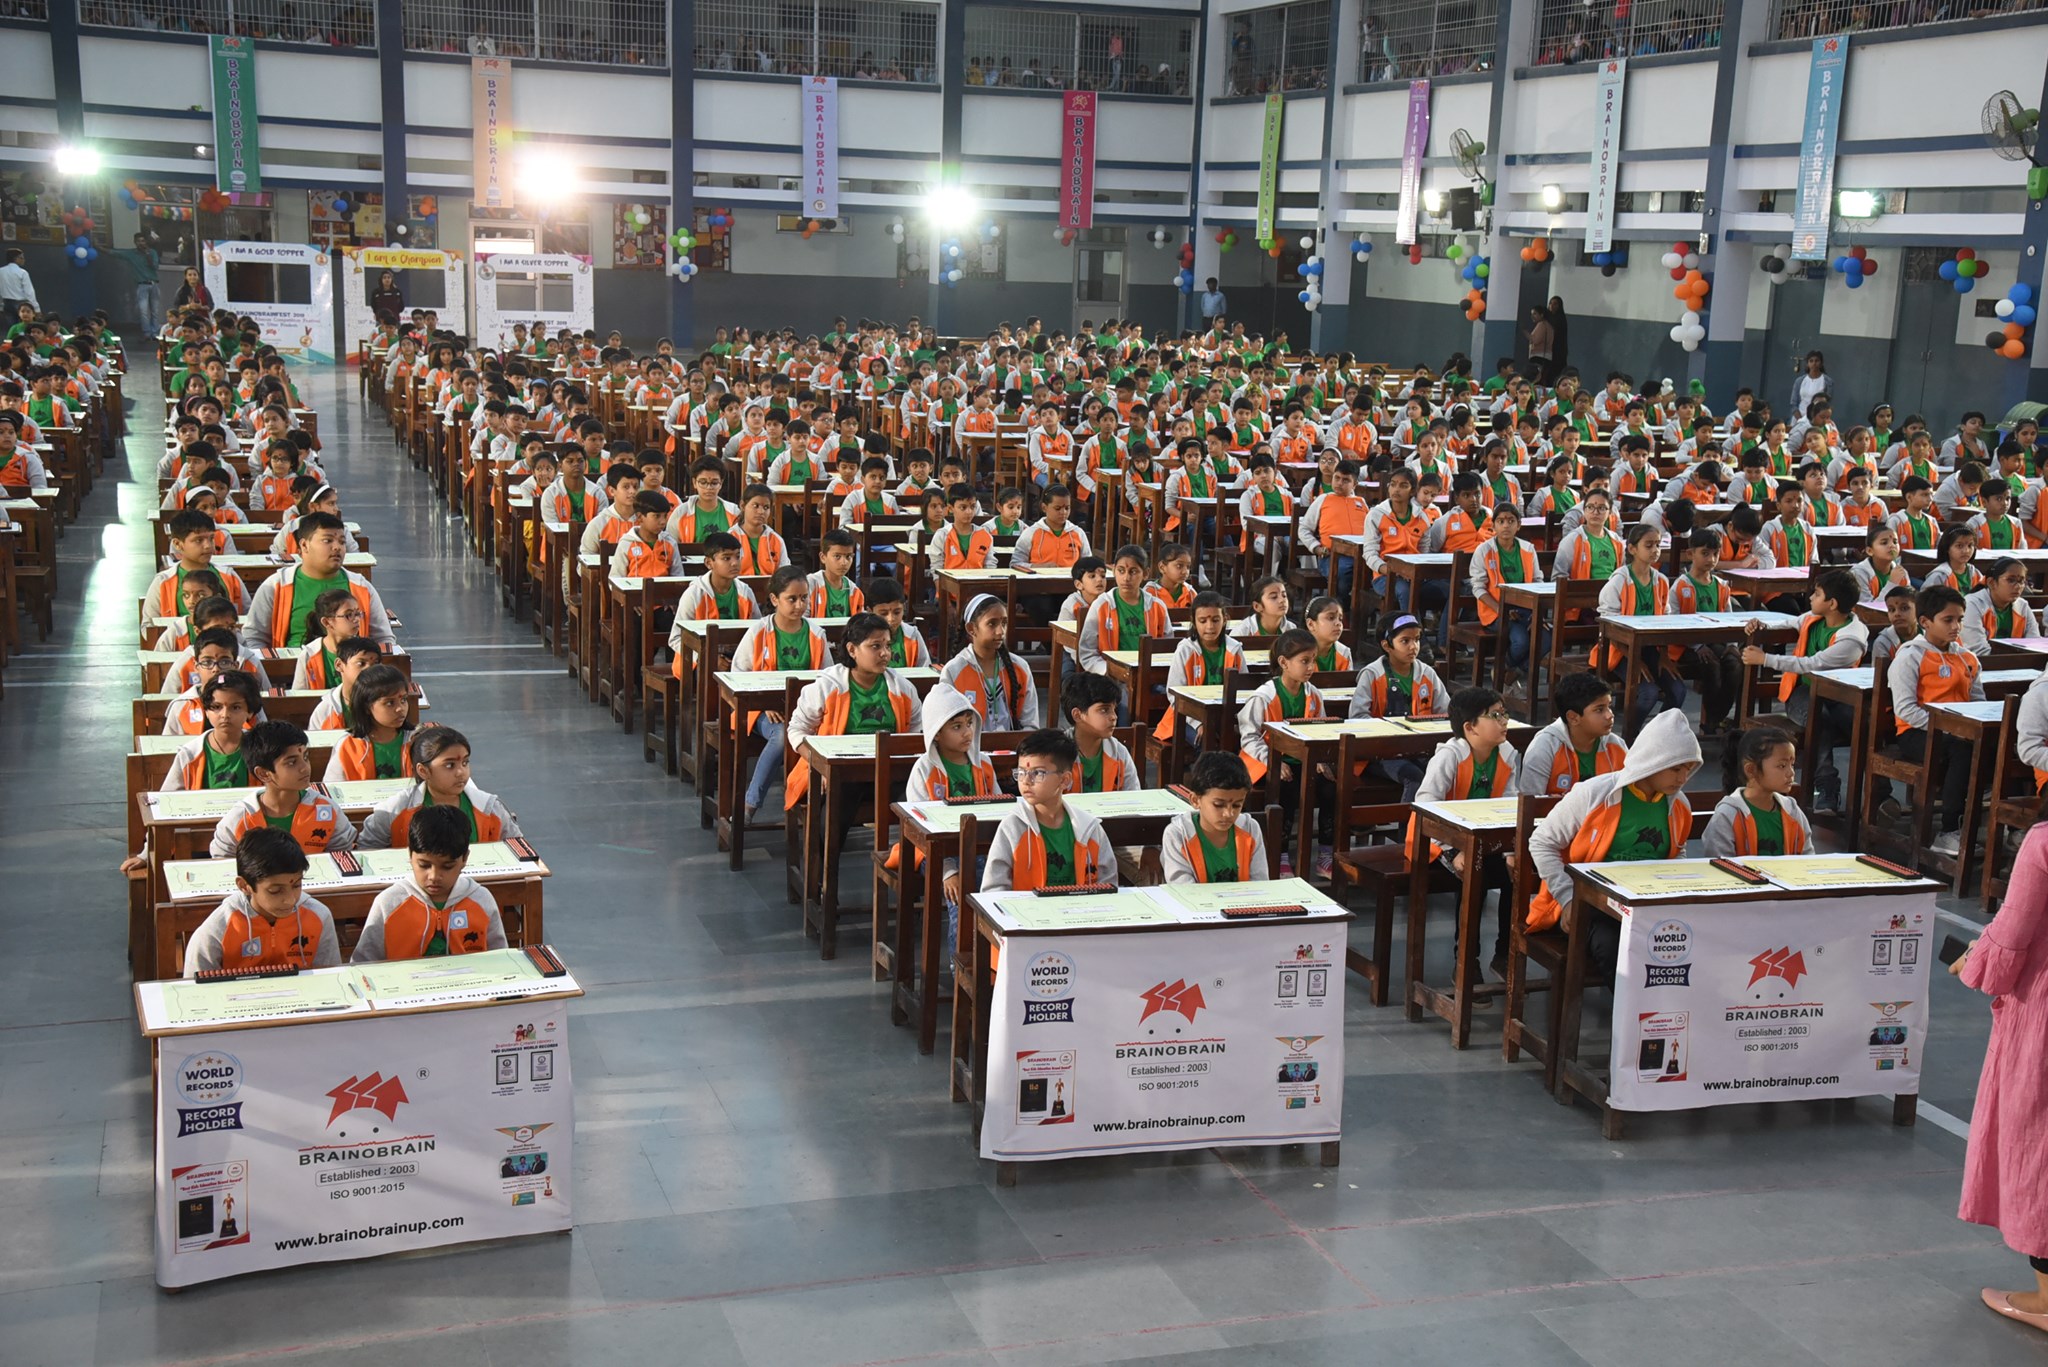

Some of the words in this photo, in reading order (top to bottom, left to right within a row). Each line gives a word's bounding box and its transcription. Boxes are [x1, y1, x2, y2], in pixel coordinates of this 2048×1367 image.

[227, 59, 242, 168] BRAINOBRAIN
[487, 79, 497, 184] BRAINOBRAIN
[815, 95, 825, 194] BRAINOBRAIN
[1807, 70, 1832, 224] BRAINOBRAIN
[1596, 89, 1613, 222] BRAINOBRAIN
[1070, 117, 1084, 225] BRAINOBRAIN
[277, 249, 304, 257] TOPPER
[374, 255, 389, 265] am
[400, 254, 441, 266] Champion
[1653, 934, 1687, 943] WORLD
[1031, 966, 1069, 977] WORLD
[1649, 968, 1686, 976] RECORD
[1031, 978, 1068, 986] RECORDS
[1649, 976, 1685, 984] HOLDER
[1029, 1002, 1069, 1012] RECORD
[1725, 1008, 1823, 1021] BRAINOBRAIN
[1028, 1012, 1068, 1022] HOLDER
[1738, 1027, 1782, 1038] Established
[1788, 1026, 1807, 1035] 2003
[1115, 1043, 1226, 1059] BRAINOBRAIN
[1744, 1044, 1759, 1052] ISO
[1760, 1042, 1799, 1051] 9001:2015
[185, 1066, 234, 1081] WORLD
[1131, 1065, 1181, 1076] Established
[1187, 1063, 1208, 1072] 2003
[186, 1080, 234, 1092] RECORDS
[1138, 1083, 1154, 1091] ISO
[1156, 1080, 1199, 1089] 9001:2015
[1703, 1075, 1839, 1091] www.brainobrainup.com
[185, 1107, 236, 1122] RECORD
[185, 1118, 236, 1133] HOLDER
[1093, 1114, 1245, 1132] www.brainobrainup.com
[299, 1140, 435, 1166] BRAINOBRAIN
[319, 1166, 381, 1183] Established
[389, 1164, 416, 1175] 2003
[330, 1190, 350, 1200] ISO
[352, 1182, 405, 1197] 9001:2015
[275, 1216, 464, 1251] www.brainobrainup.com
